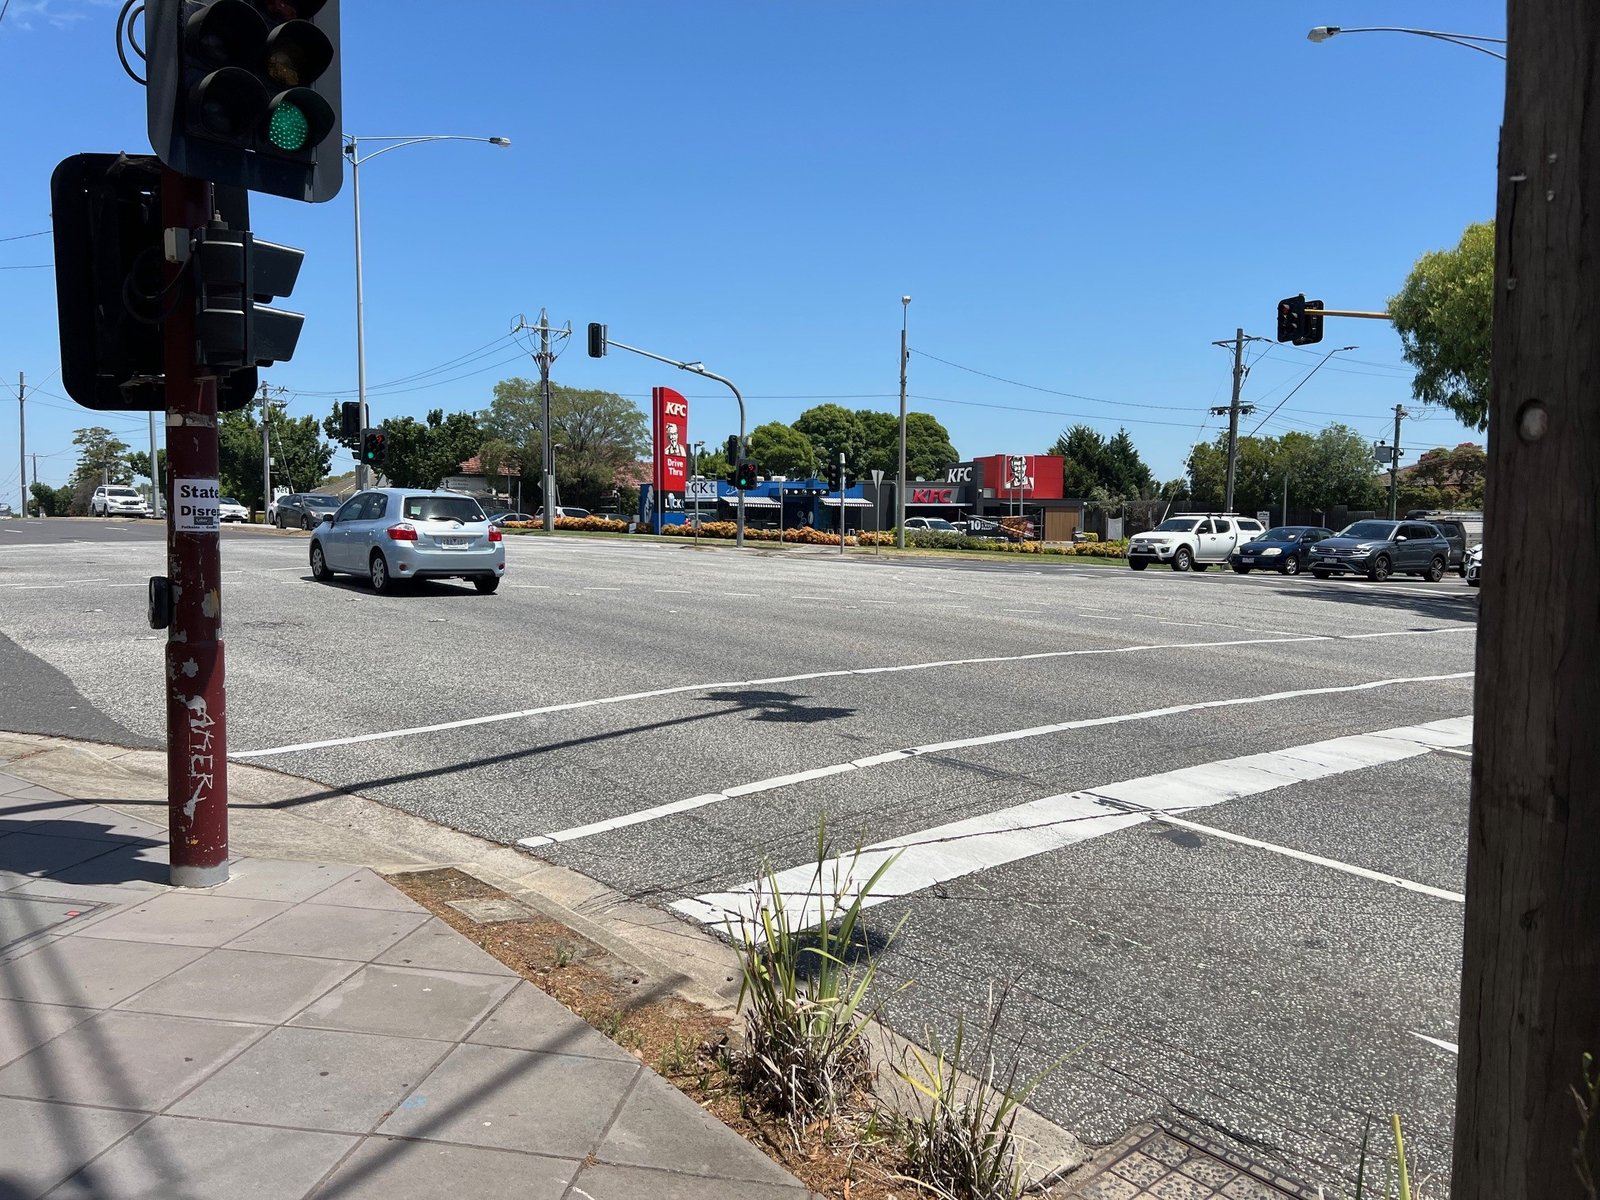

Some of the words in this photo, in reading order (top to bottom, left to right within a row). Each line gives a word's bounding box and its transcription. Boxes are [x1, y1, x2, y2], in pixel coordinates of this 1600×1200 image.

[665, 402, 687, 417] KFC
[667, 458, 684, 468] Drive
[668, 467, 683, 477] Thru
[947, 467, 973, 483] KFC
[438, 480, 450, 489] et
[180, 485, 219, 499] State
[912, 488, 953, 504] KFC
